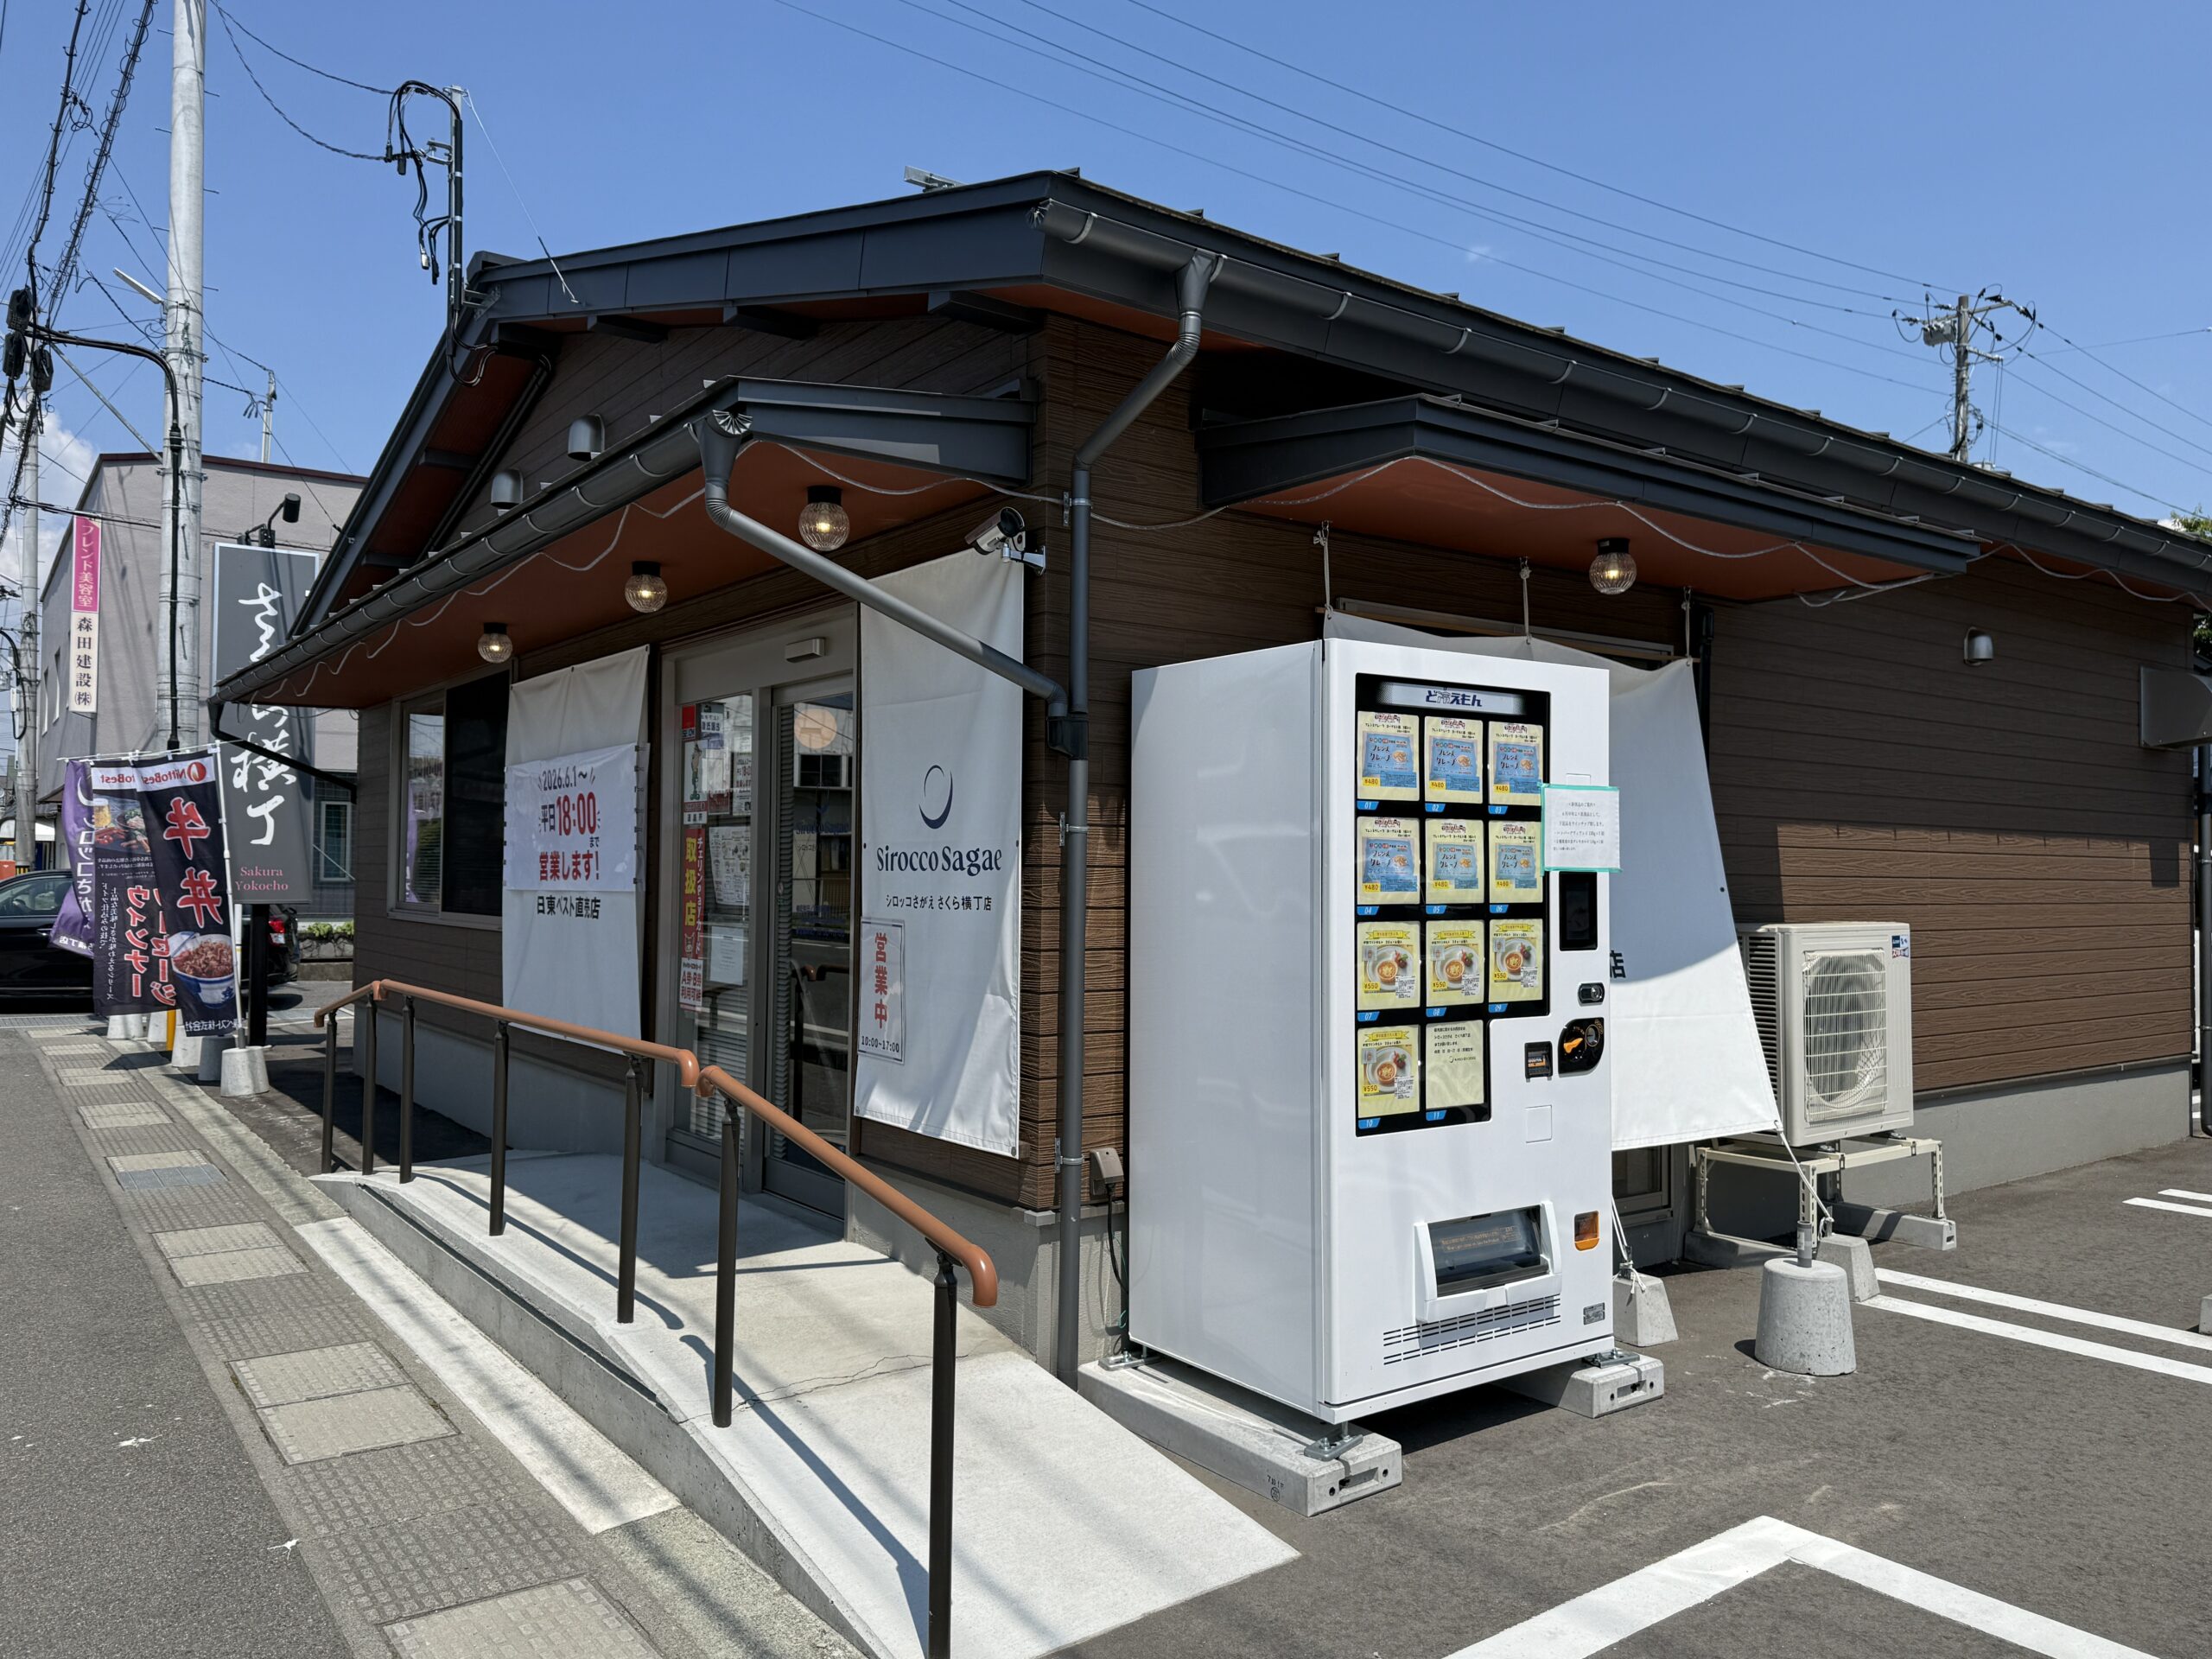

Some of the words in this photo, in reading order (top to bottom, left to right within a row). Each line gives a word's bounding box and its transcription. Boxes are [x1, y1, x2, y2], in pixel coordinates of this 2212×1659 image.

[79, 524, 93, 607] フレンド美容室
[1426, 688, 1482, 707] ど冷えもん
[1364, 801, 1371, 810] 01
[1432, 804, 1440, 812] 02
[541, 804, 556, 832] 平日
[556, 791, 596, 836] 18:00
[589, 836, 600, 848] まで
[239, 866, 283, 877] Sakura
[234, 880, 289, 892] Yokocho
[684, 836, 697, 927] 取扱店
[537, 895, 601, 920] 日東ベスト直売店
[886, 894, 934, 910] シロッコさがえ
[938, 894, 992, 912] さくら横丁店
[1433, 905, 1440, 913] 05
[1610, 950, 1626, 978] 店
[874, 931, 888, 1029] 営業中
[1433, 1007, 1440, 1016] 08
[1495, 1003, 1502, 1012] 09
